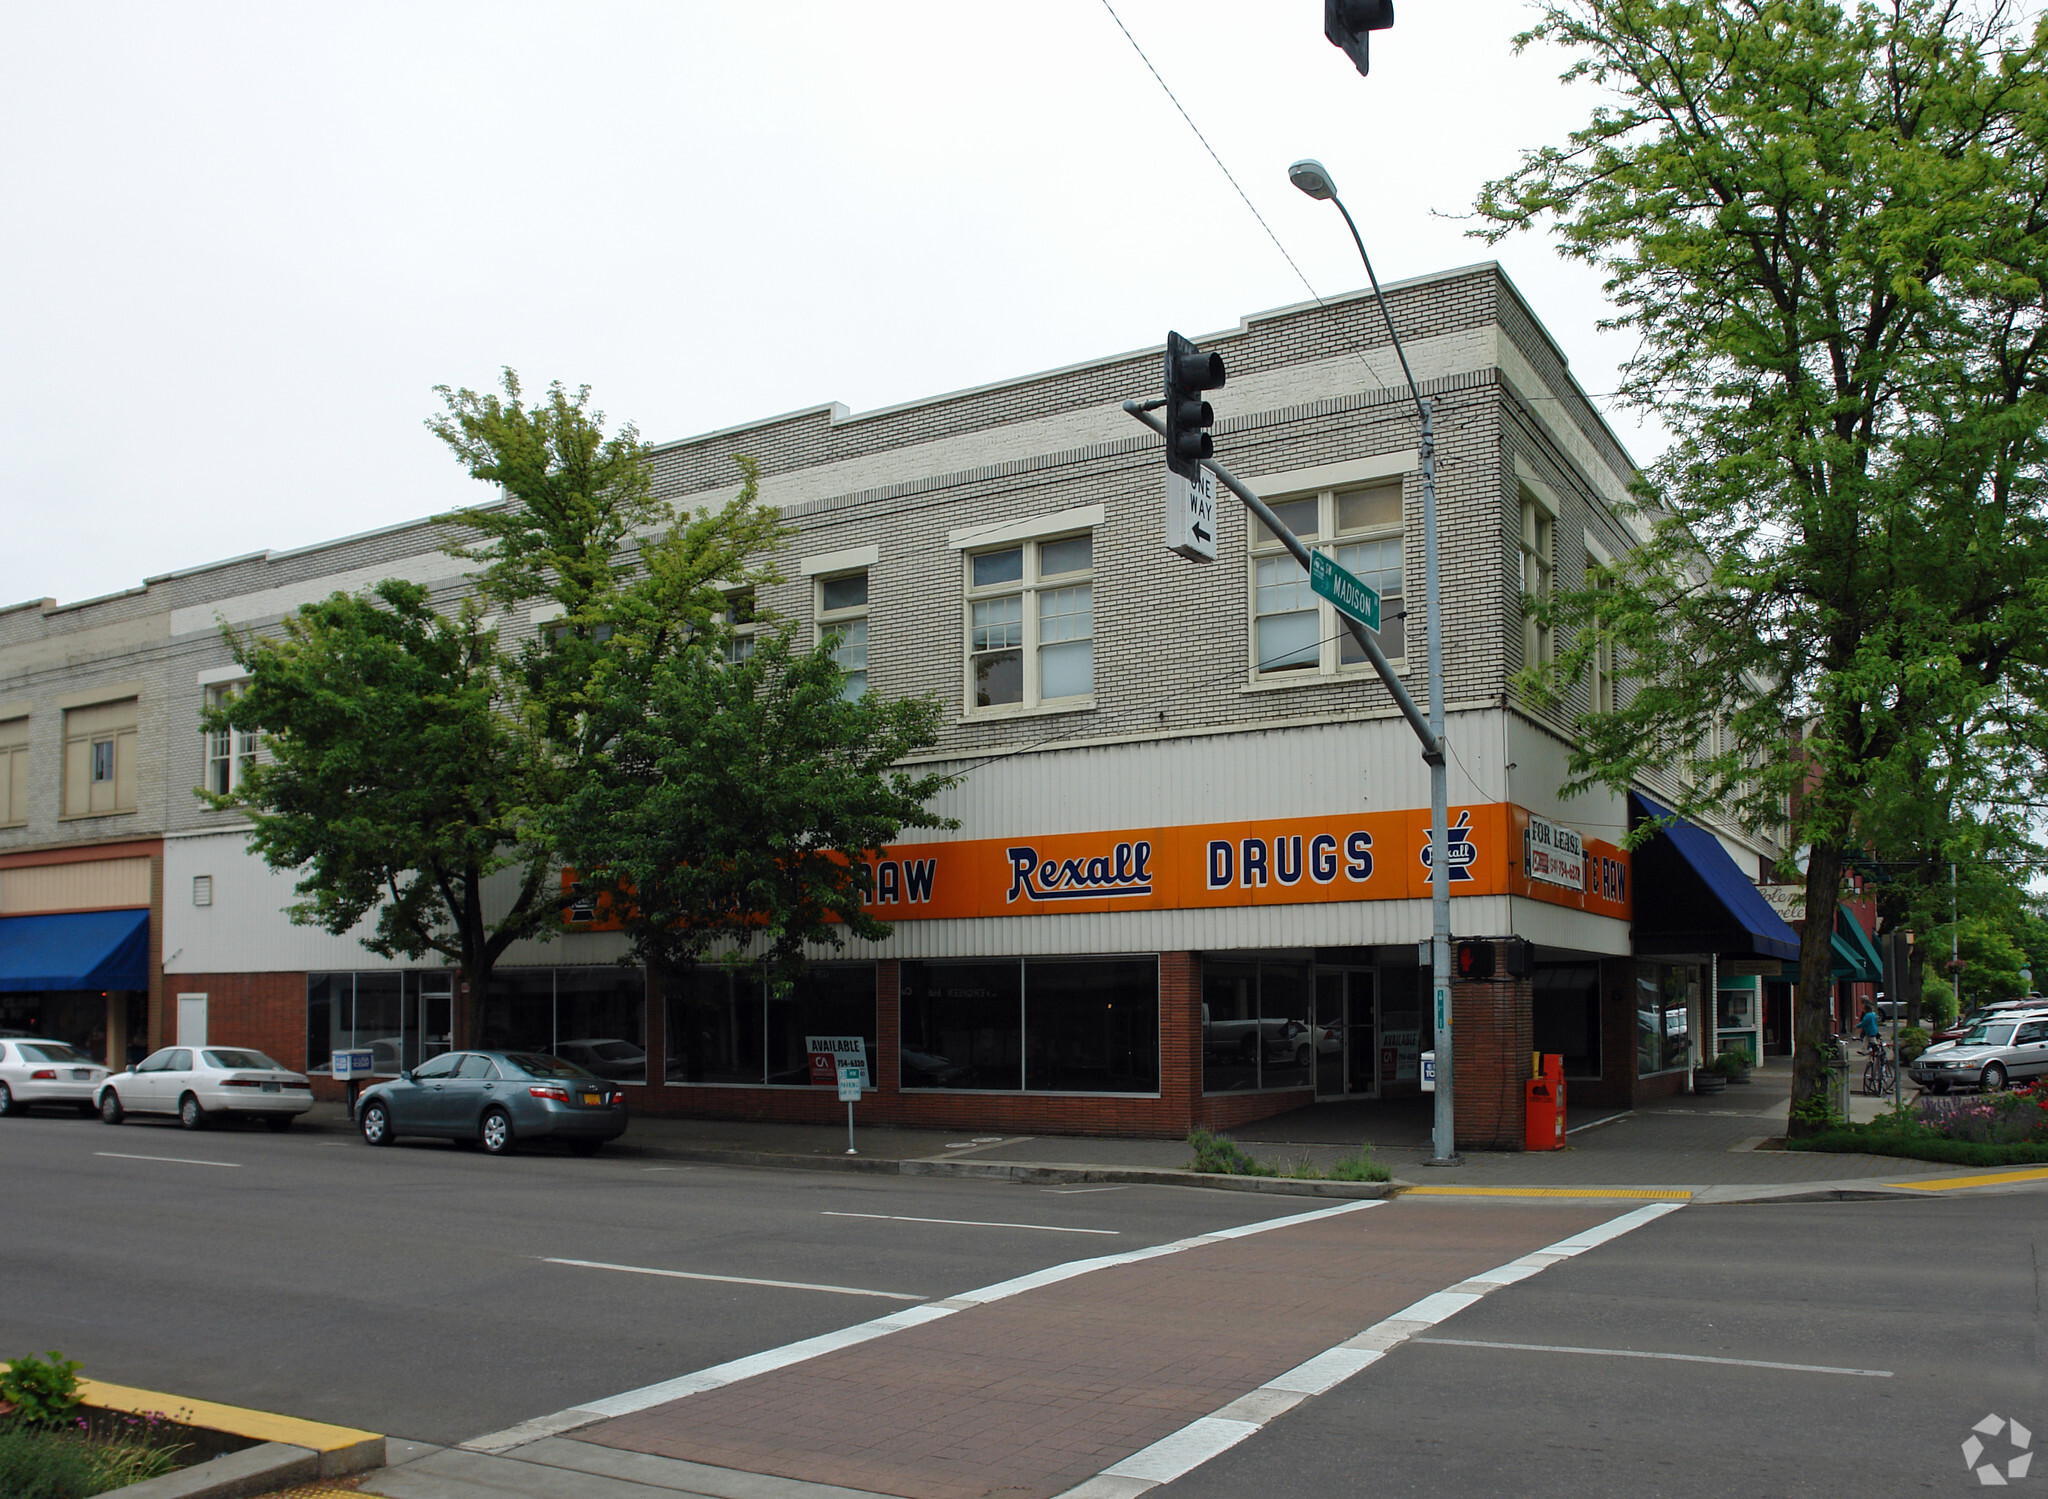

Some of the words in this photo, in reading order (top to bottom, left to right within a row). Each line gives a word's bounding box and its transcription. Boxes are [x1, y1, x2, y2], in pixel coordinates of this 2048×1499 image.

[1190, 493, 1212, 521] WAY
[1333, 573, 1372, 617] MADISON
[1207, 830, 1374, 890] DRUGS
[1531, 820, 1551, 846] FOR
[1553, 828, 1580, 856] LEASE
[1007, 841, 1152, 903] Rexall
[1602, 856, 1626, 904] RAW
[811, 1040, 860, 1052] AVAILABLE
